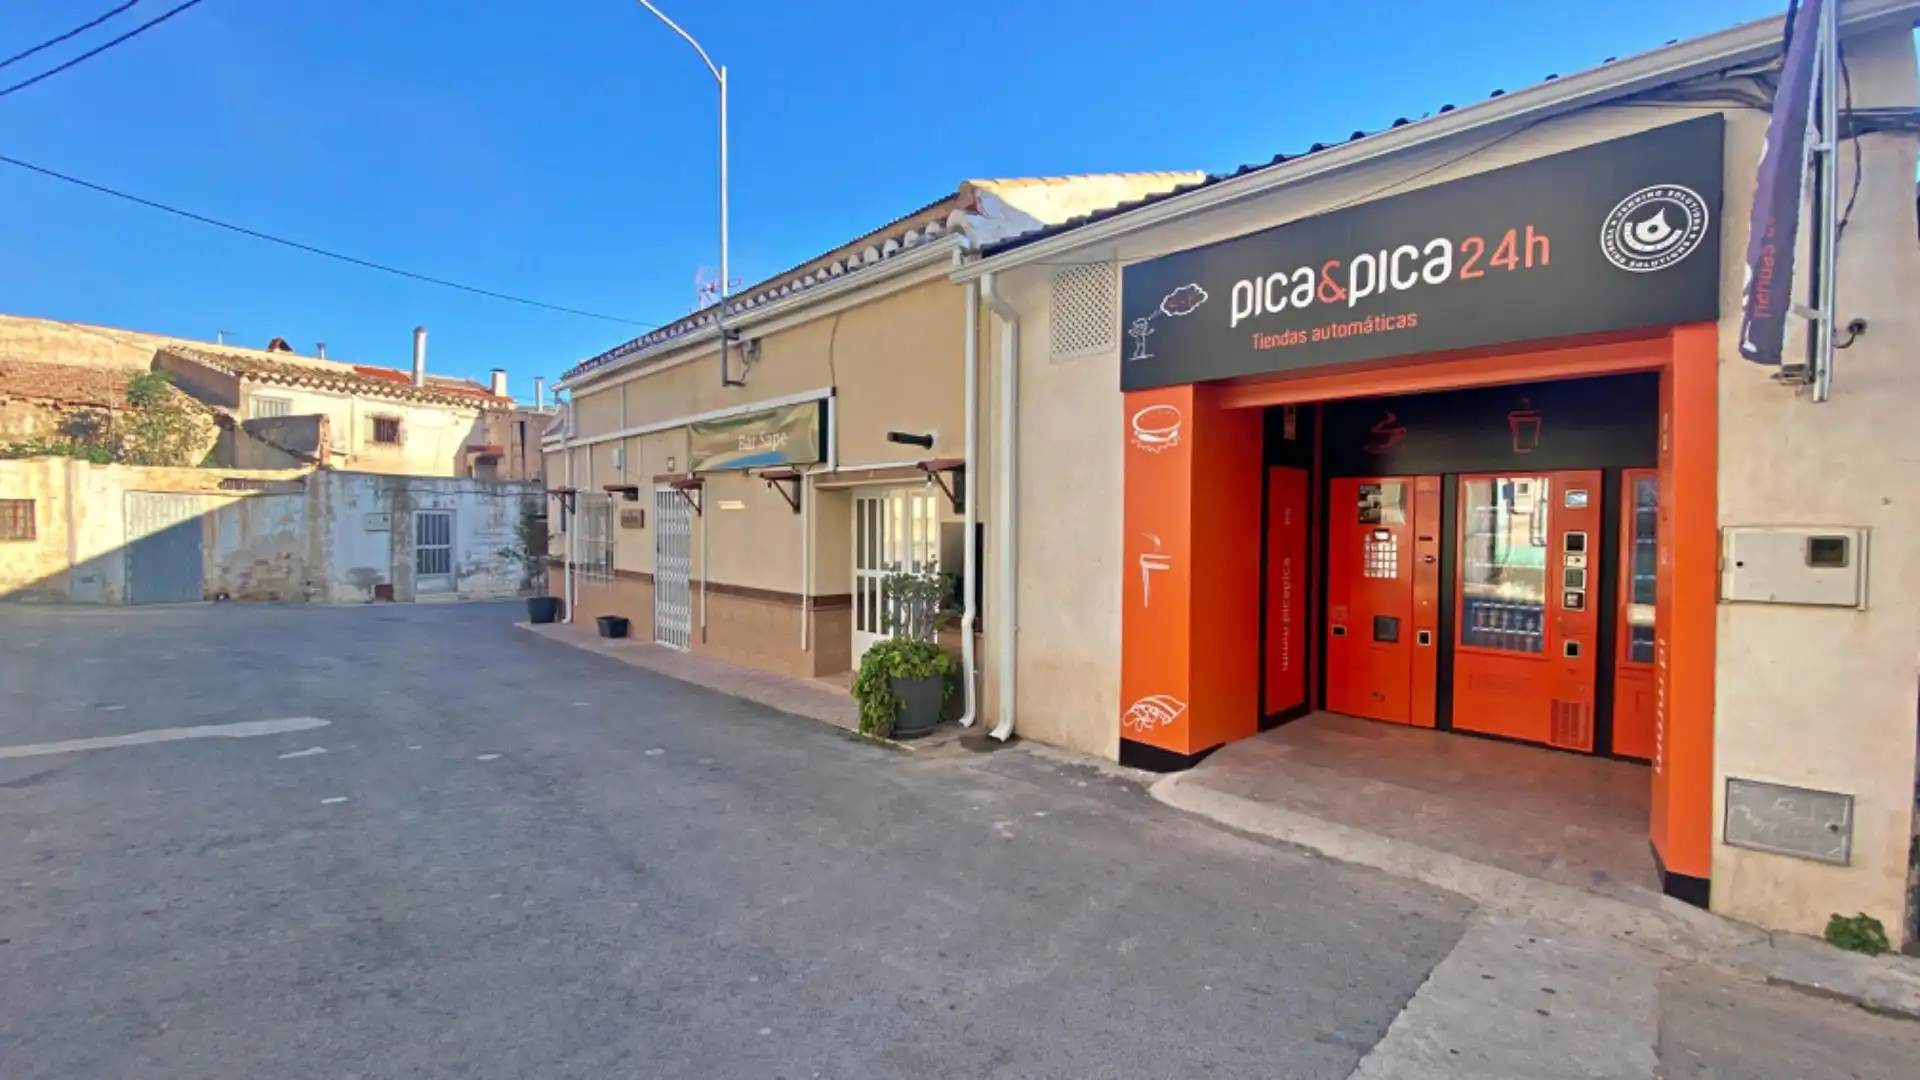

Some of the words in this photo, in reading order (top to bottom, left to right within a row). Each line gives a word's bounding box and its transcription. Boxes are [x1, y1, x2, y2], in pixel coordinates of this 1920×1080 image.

[1252, 329, 1307, 350] Tiendas
[1312, 311, 1418, 342] automáticas
[738, 435, 756, 451] Bar
